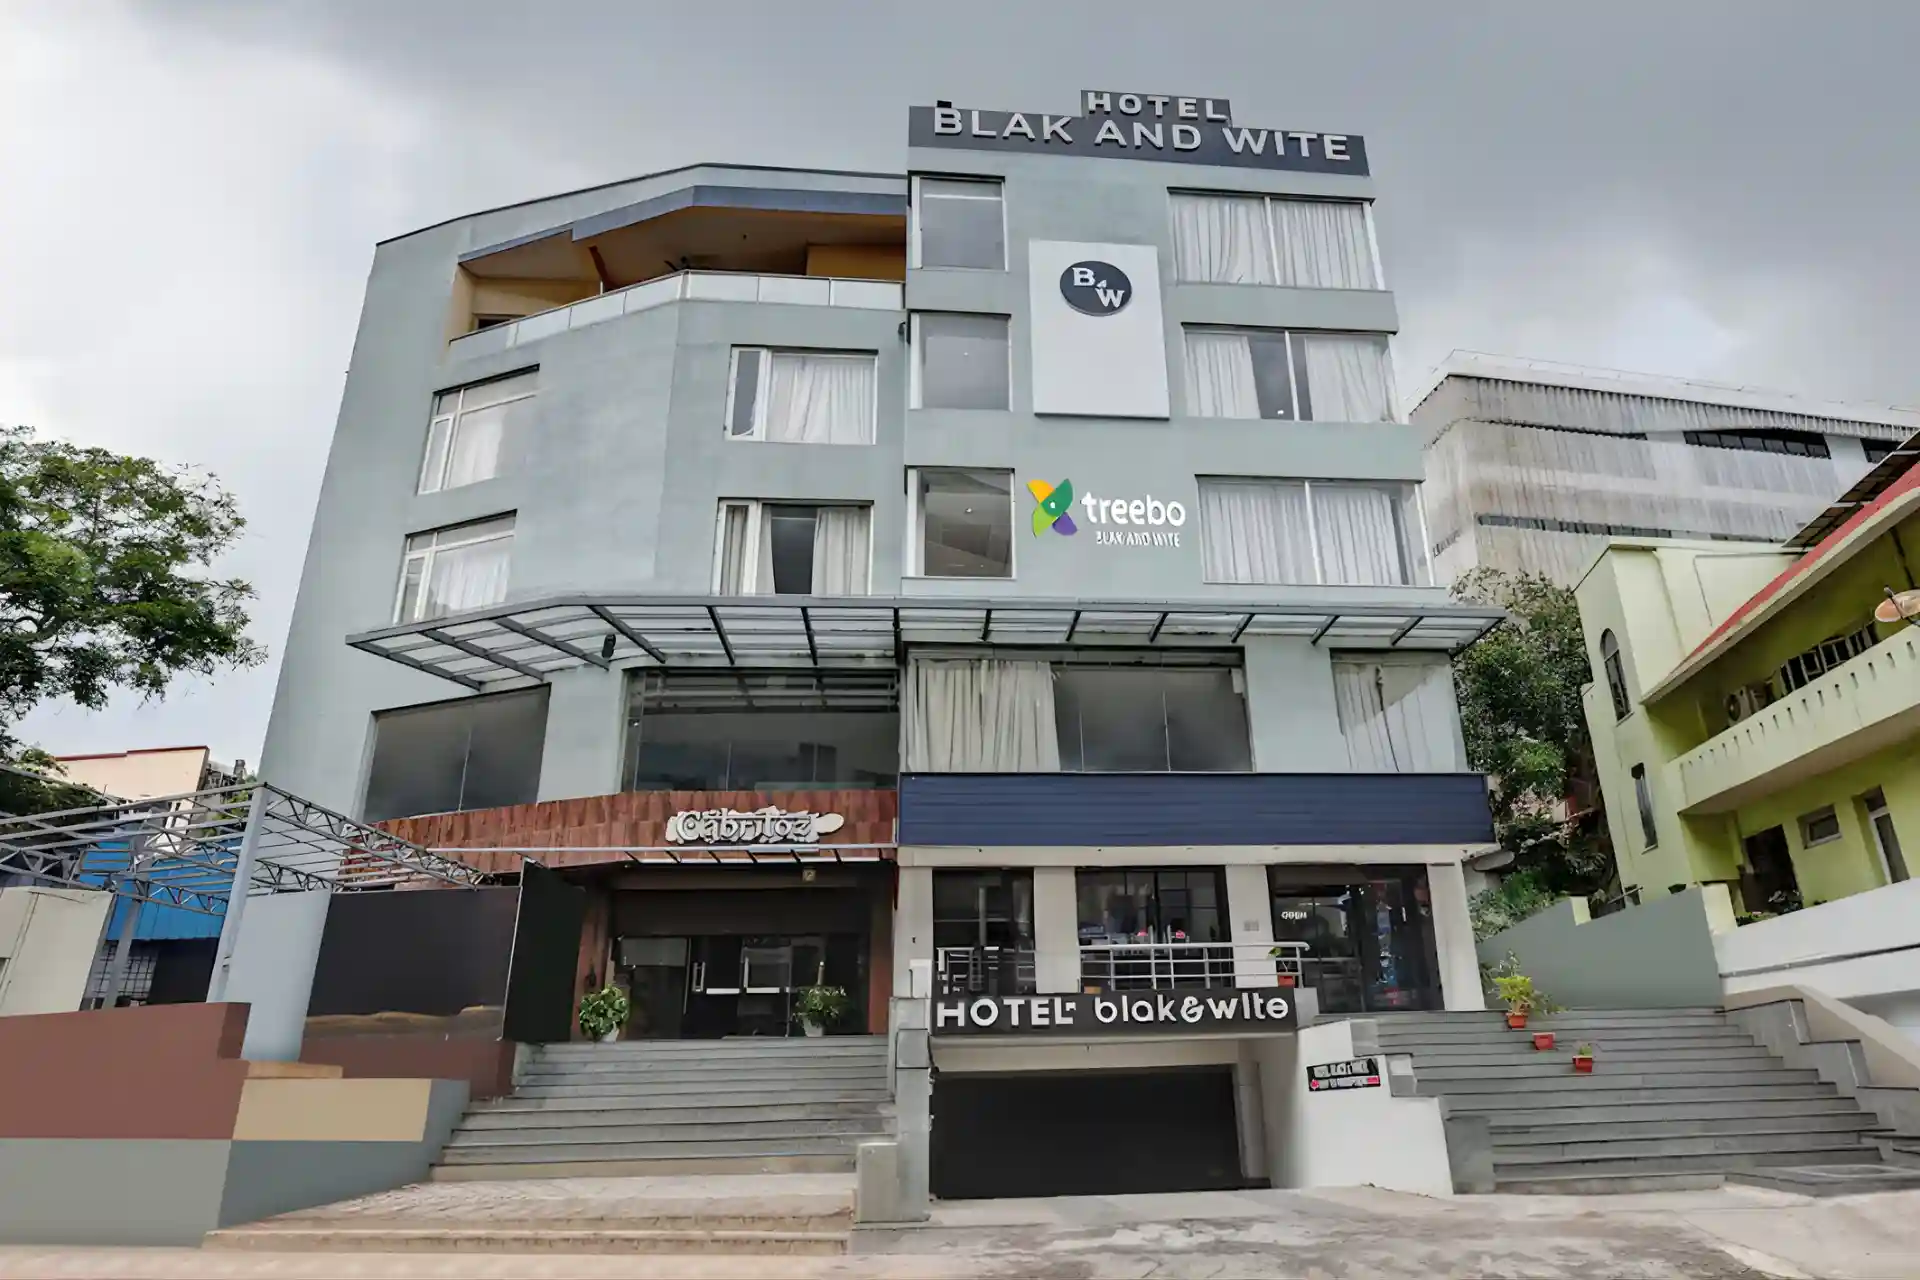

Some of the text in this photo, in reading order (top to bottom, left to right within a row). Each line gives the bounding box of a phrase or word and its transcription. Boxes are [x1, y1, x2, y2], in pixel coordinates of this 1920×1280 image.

[1088, 92, 1228, 121] HOTEL
[935, 107, 1350, 160] BLAK AND WITE
[1080, 491, 1186, 526] treebo
[937, 997, 1074, 1027] HOTEL
